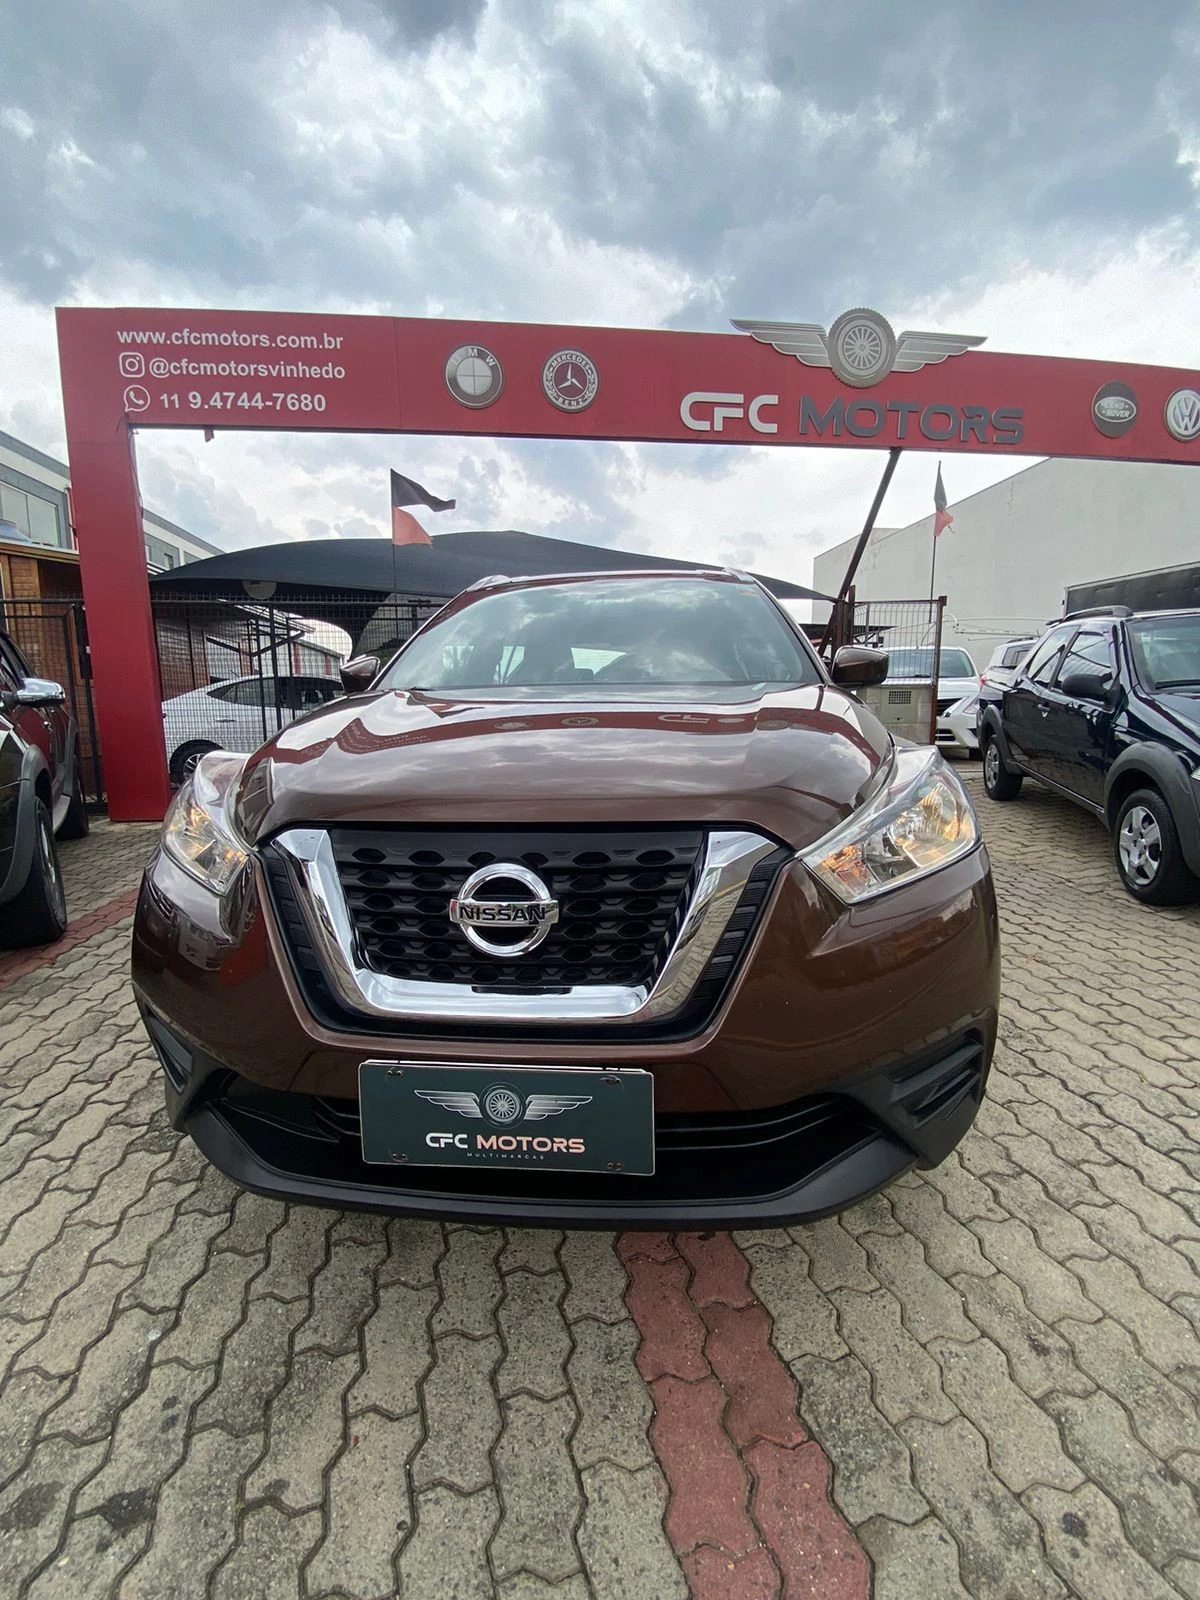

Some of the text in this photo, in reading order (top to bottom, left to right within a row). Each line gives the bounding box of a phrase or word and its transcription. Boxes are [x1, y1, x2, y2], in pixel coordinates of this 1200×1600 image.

[116, 328, 344, 350] www.cfcmotors.com.br
[452, 348, 496, 366] BMW
[551, 353, 591, 371] MERCEDES
[149, 357, 346, 379] @cfcmotorsvinhedo
[159, 391, 326, 412] 11 9.4744-7680
[557, 397, 584, 407] BENZ
[679, 391, 1025, 445] CFC MOTORS
[460, 906, 546, 921] NISSAN
[425, 1132, 586, 1154] CFC MOTORS
[466, 1152, 545, 1160] MULTIMARCAS
